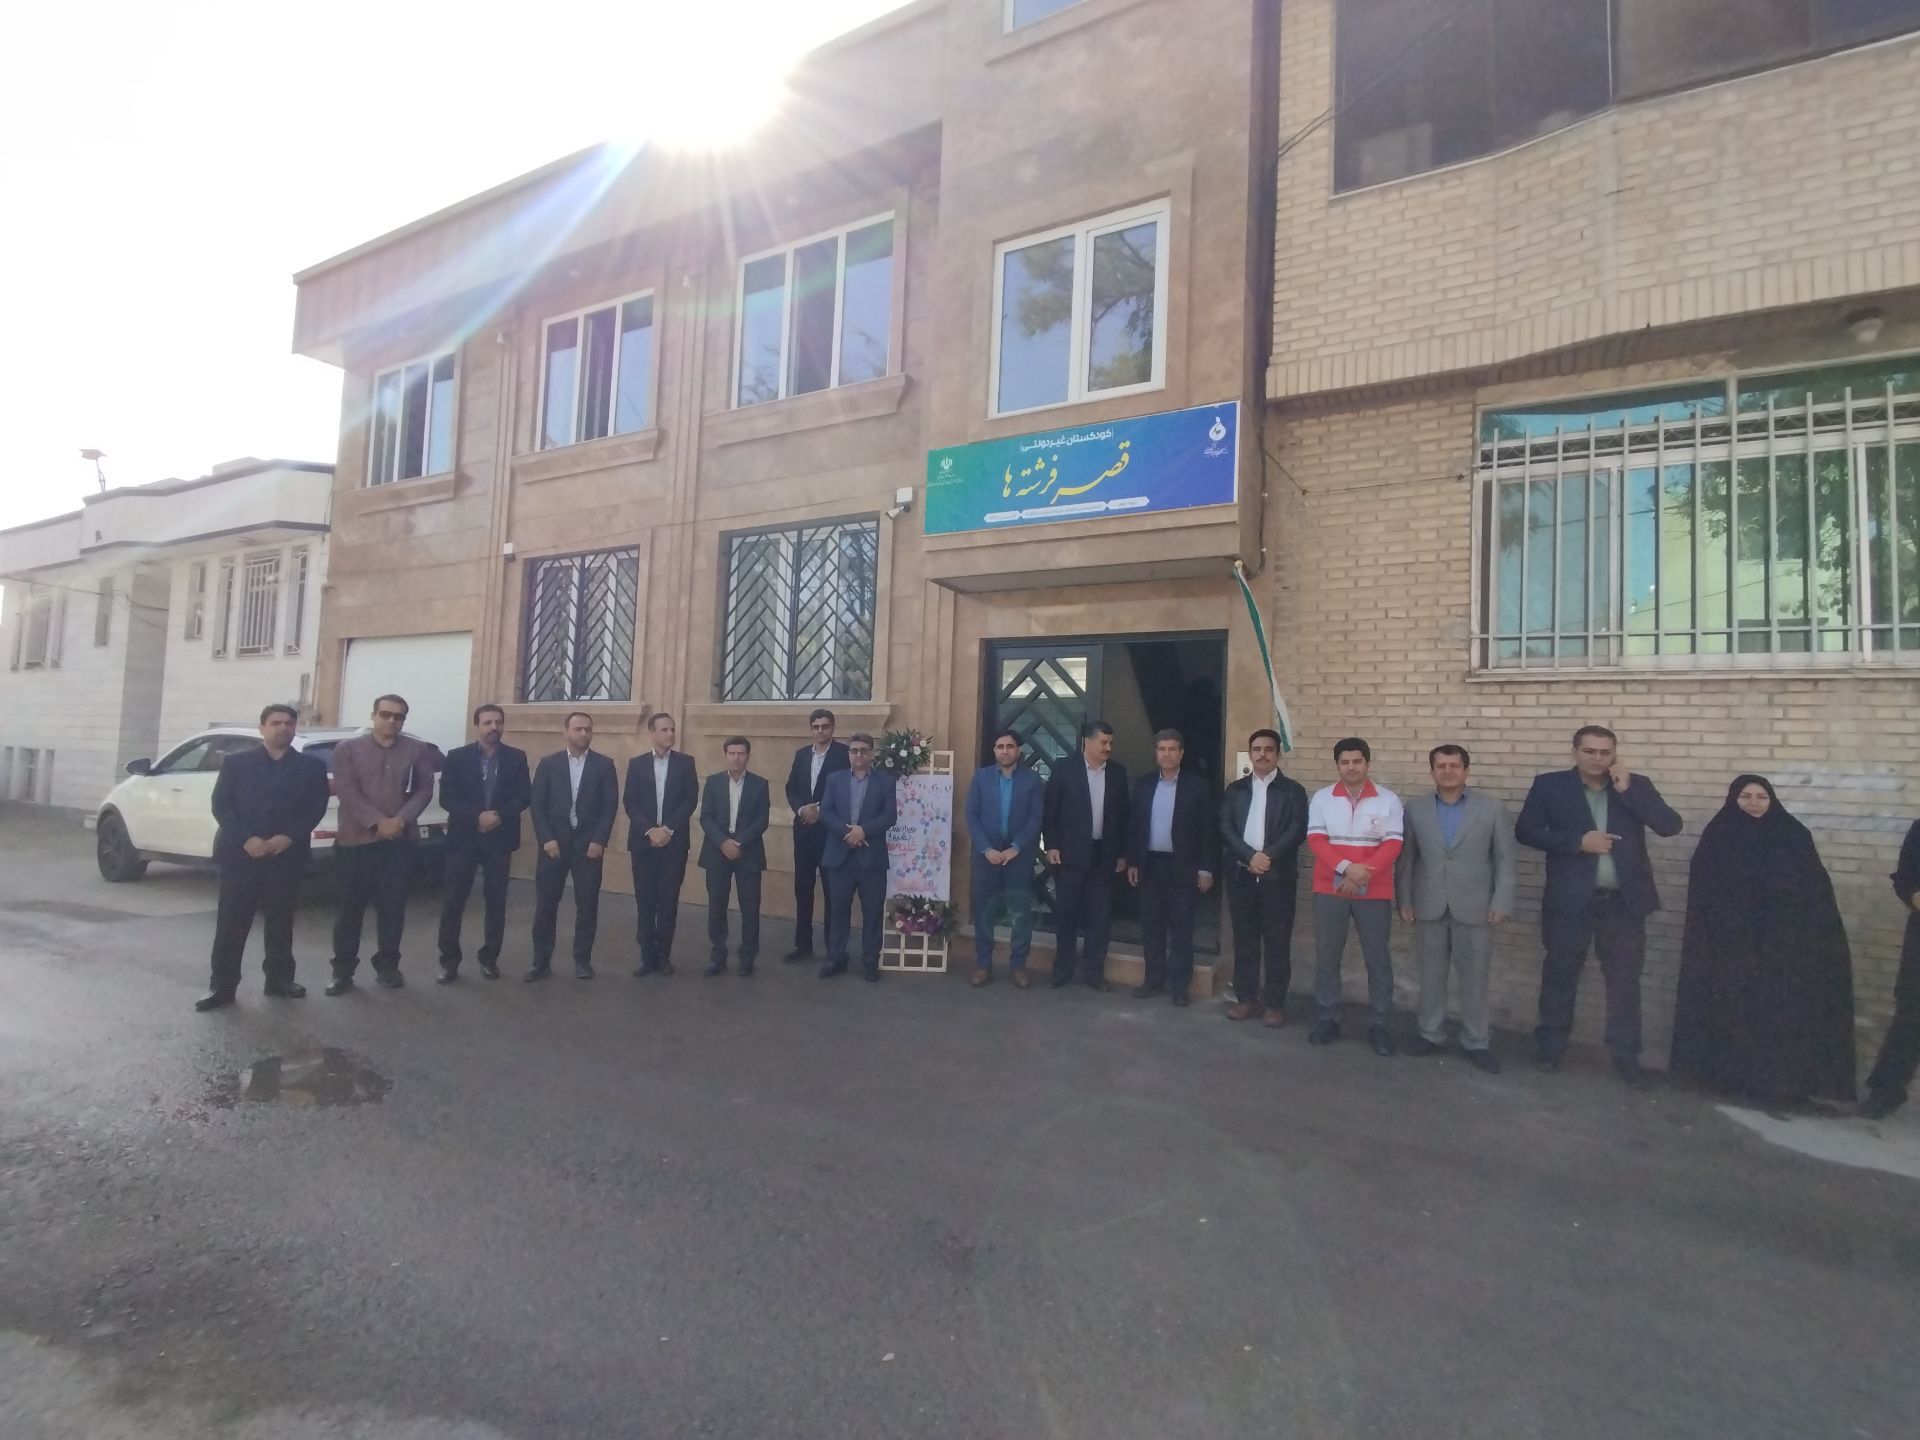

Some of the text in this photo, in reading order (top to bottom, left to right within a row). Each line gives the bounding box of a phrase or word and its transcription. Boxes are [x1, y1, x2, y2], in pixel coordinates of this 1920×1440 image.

[1066, 428, 1111, 446] کودکستان
[1016, 454, 1058, 497] فرشته
[1050, 440, 1131, 504] قصر
